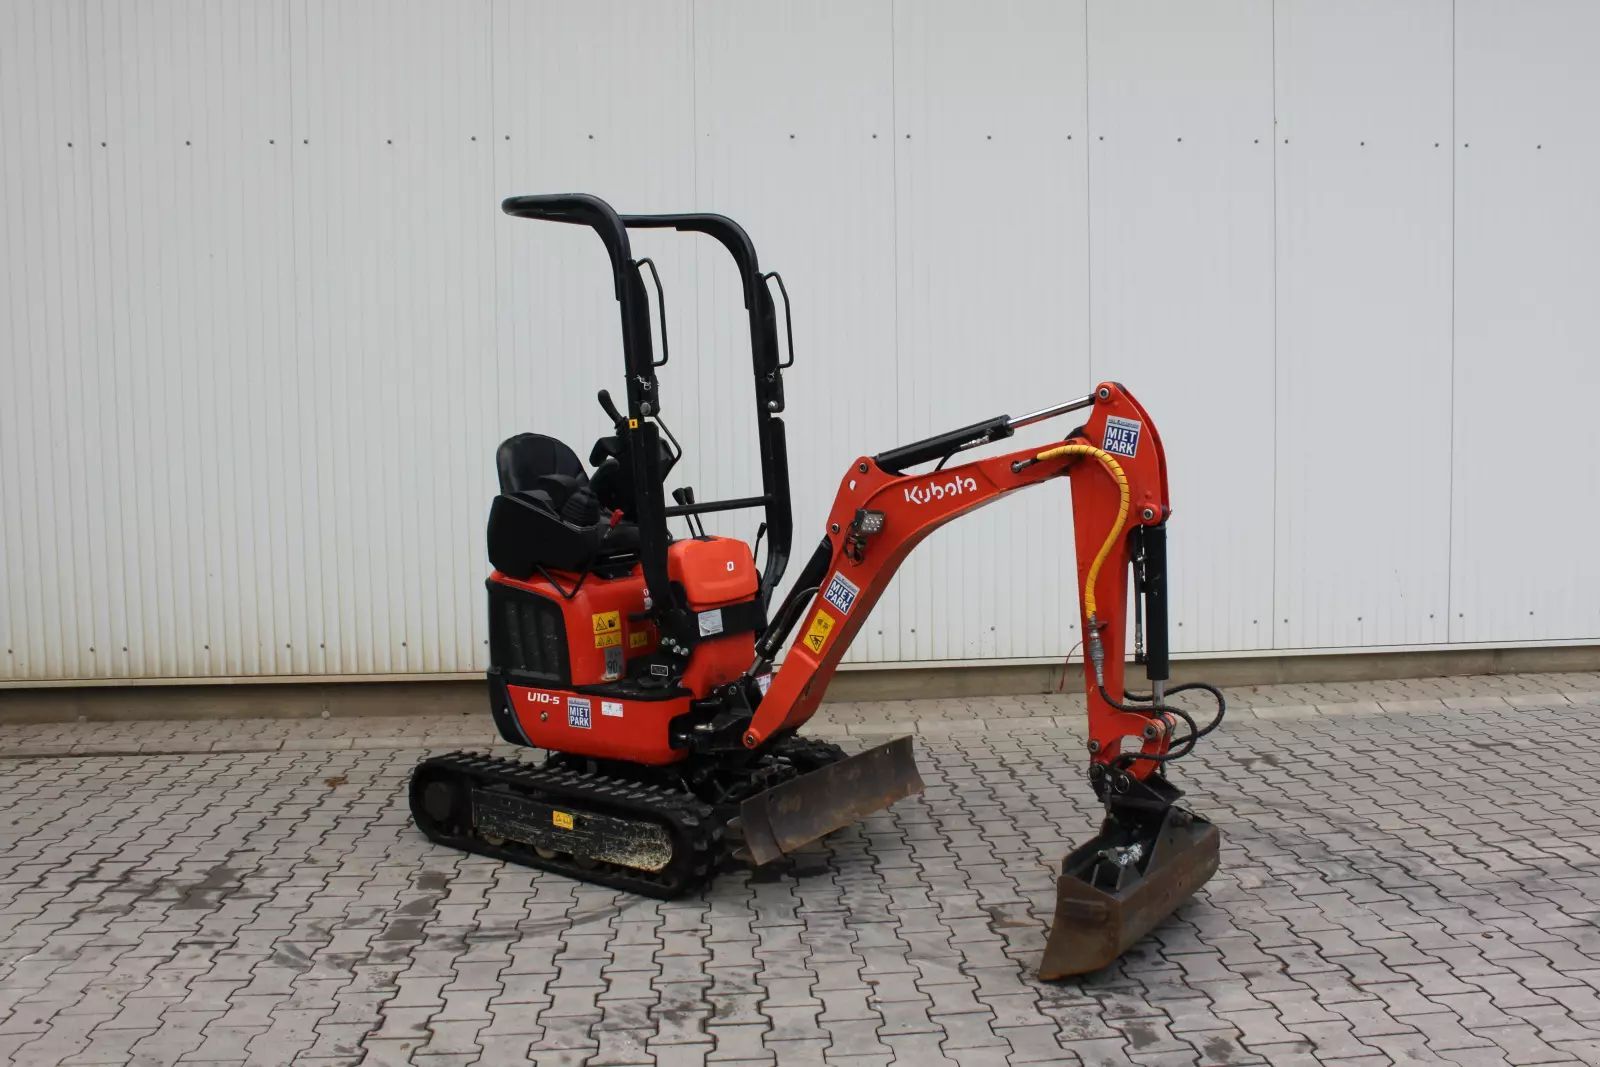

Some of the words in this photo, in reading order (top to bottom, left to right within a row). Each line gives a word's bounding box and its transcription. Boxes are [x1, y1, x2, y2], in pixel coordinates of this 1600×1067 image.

[1107, 426, 1137, 443] MIET
[1105, 438, 1135, 455] PARK
[903, 475, 978, 505] Kubota
[826, 588, 849, 612] PARK
[830, 580, 854, 603] MIET
[569, 706, 589, 718] MIET
[570, 715, 589, 727] PARK
